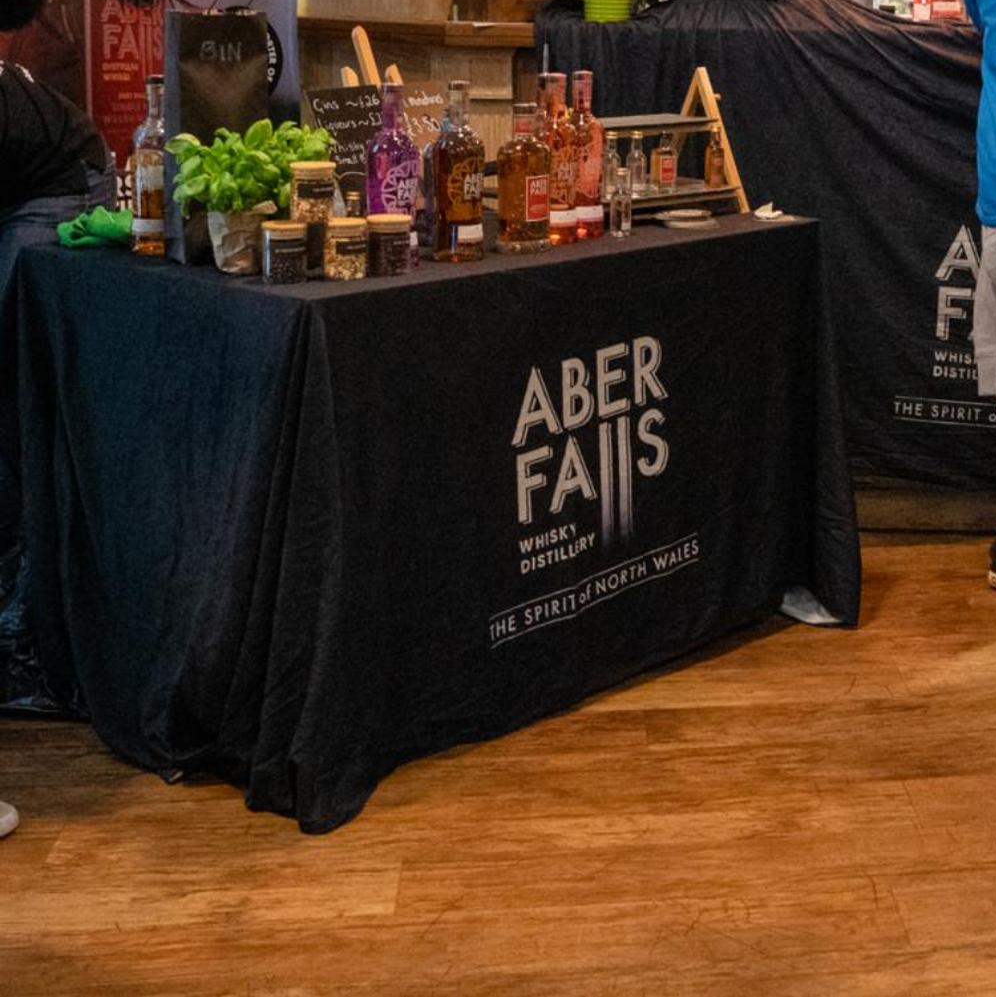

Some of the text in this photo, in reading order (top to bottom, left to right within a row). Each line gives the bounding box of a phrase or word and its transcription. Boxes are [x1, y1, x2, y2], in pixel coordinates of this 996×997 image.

[932, 365, 978, 381] DISTIL
[934, 350, 976, 365] WHIS
[511, 335, 669, 447] ABER
[894, 402, 923, 417] THE
[931, 405, 982, 421] SPIRIT
[518, 523, 577, 554] WHISKY
[520, 533, 596, 575] DISTILLERY
[489, 539, 700, 641] THE SPIRIT of NORTH WALES
